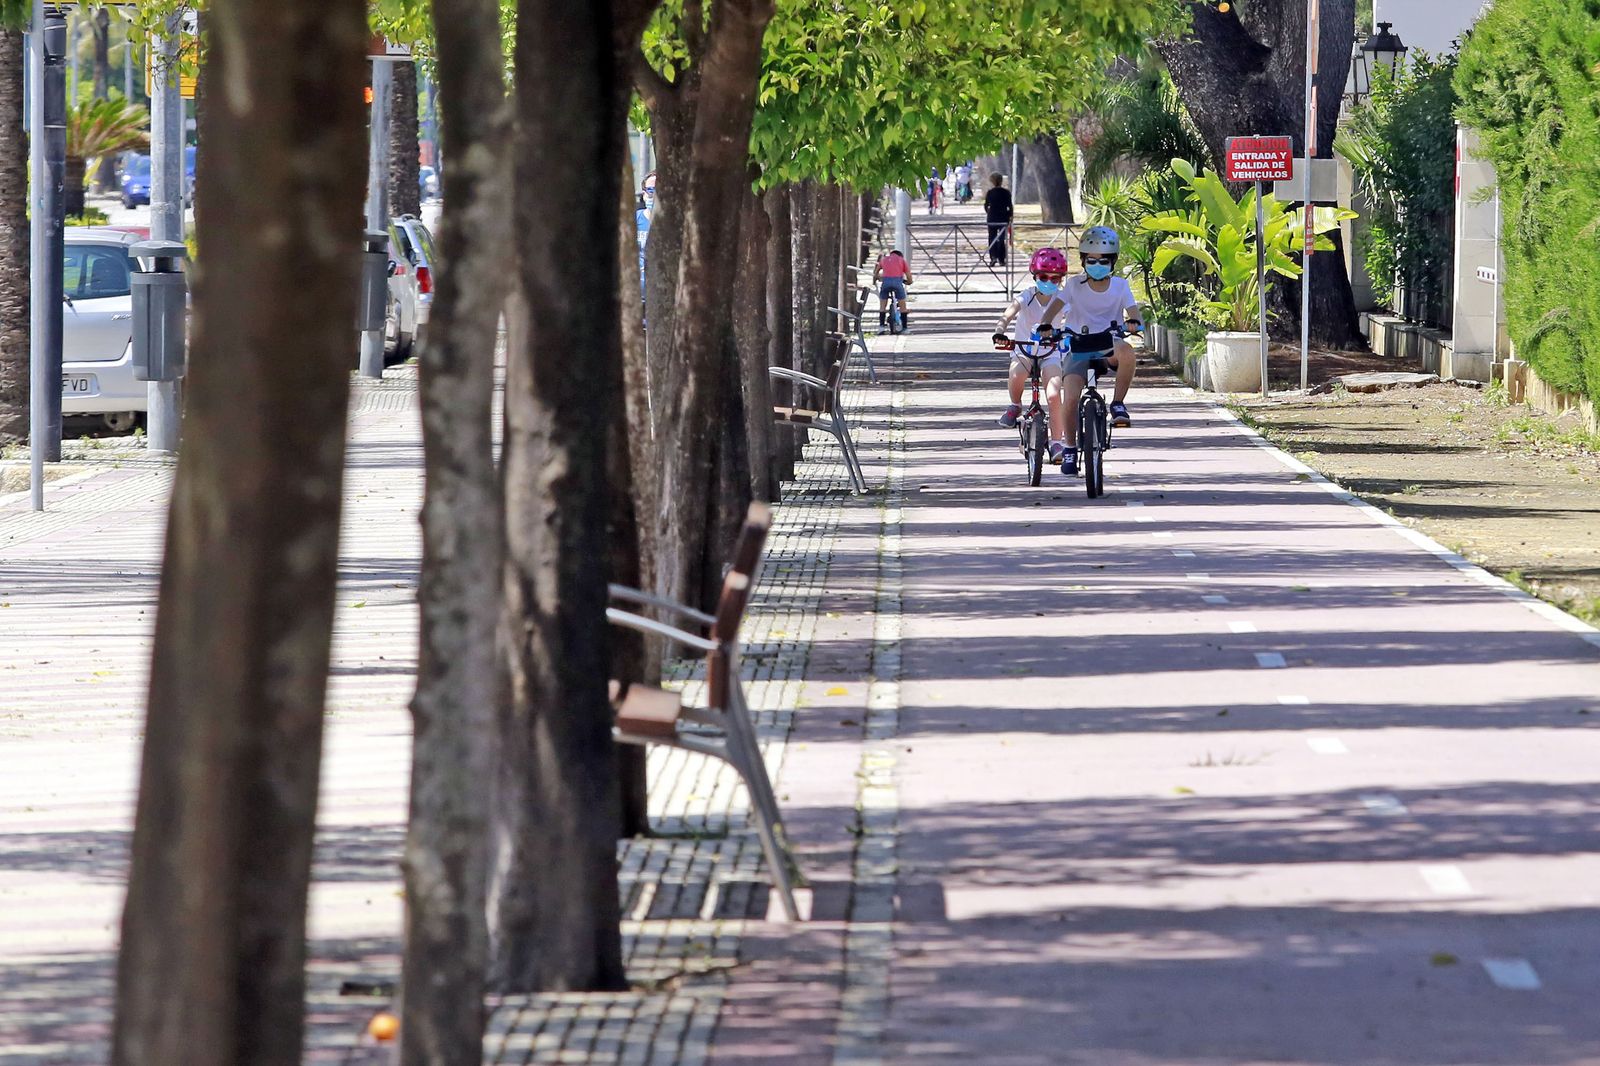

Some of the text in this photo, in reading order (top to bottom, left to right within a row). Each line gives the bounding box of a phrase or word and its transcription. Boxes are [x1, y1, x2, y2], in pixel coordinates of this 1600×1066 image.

[1231, 152, 1277, 160] ENTRADA
[1234, 161, 1270, 169] SALIDA
[1231, 171, 1288, 179] VEHICULOS
